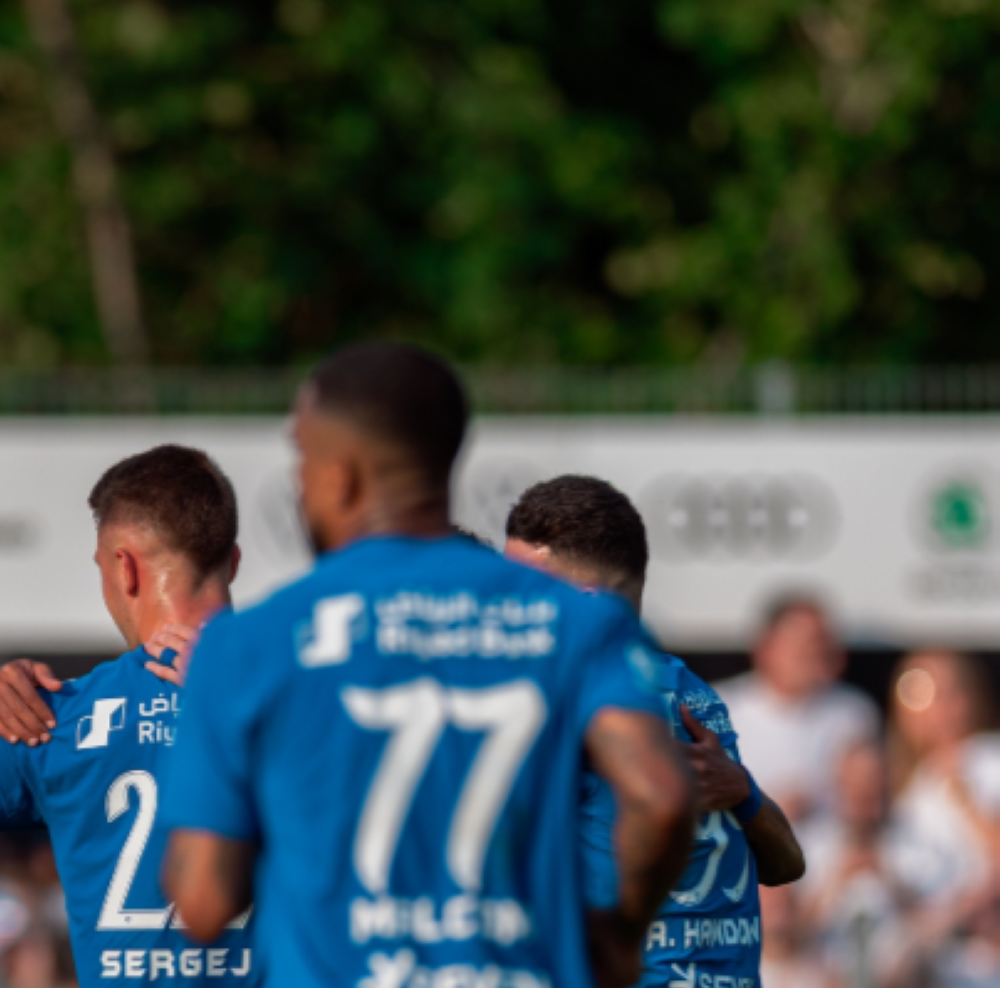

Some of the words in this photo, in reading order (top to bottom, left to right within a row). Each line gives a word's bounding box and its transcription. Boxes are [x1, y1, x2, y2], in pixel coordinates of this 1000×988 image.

[97, 769, 252, 931] 2
[341, 676, 548, 893] 77
[100, 948, 252, 981] SERGEJ
